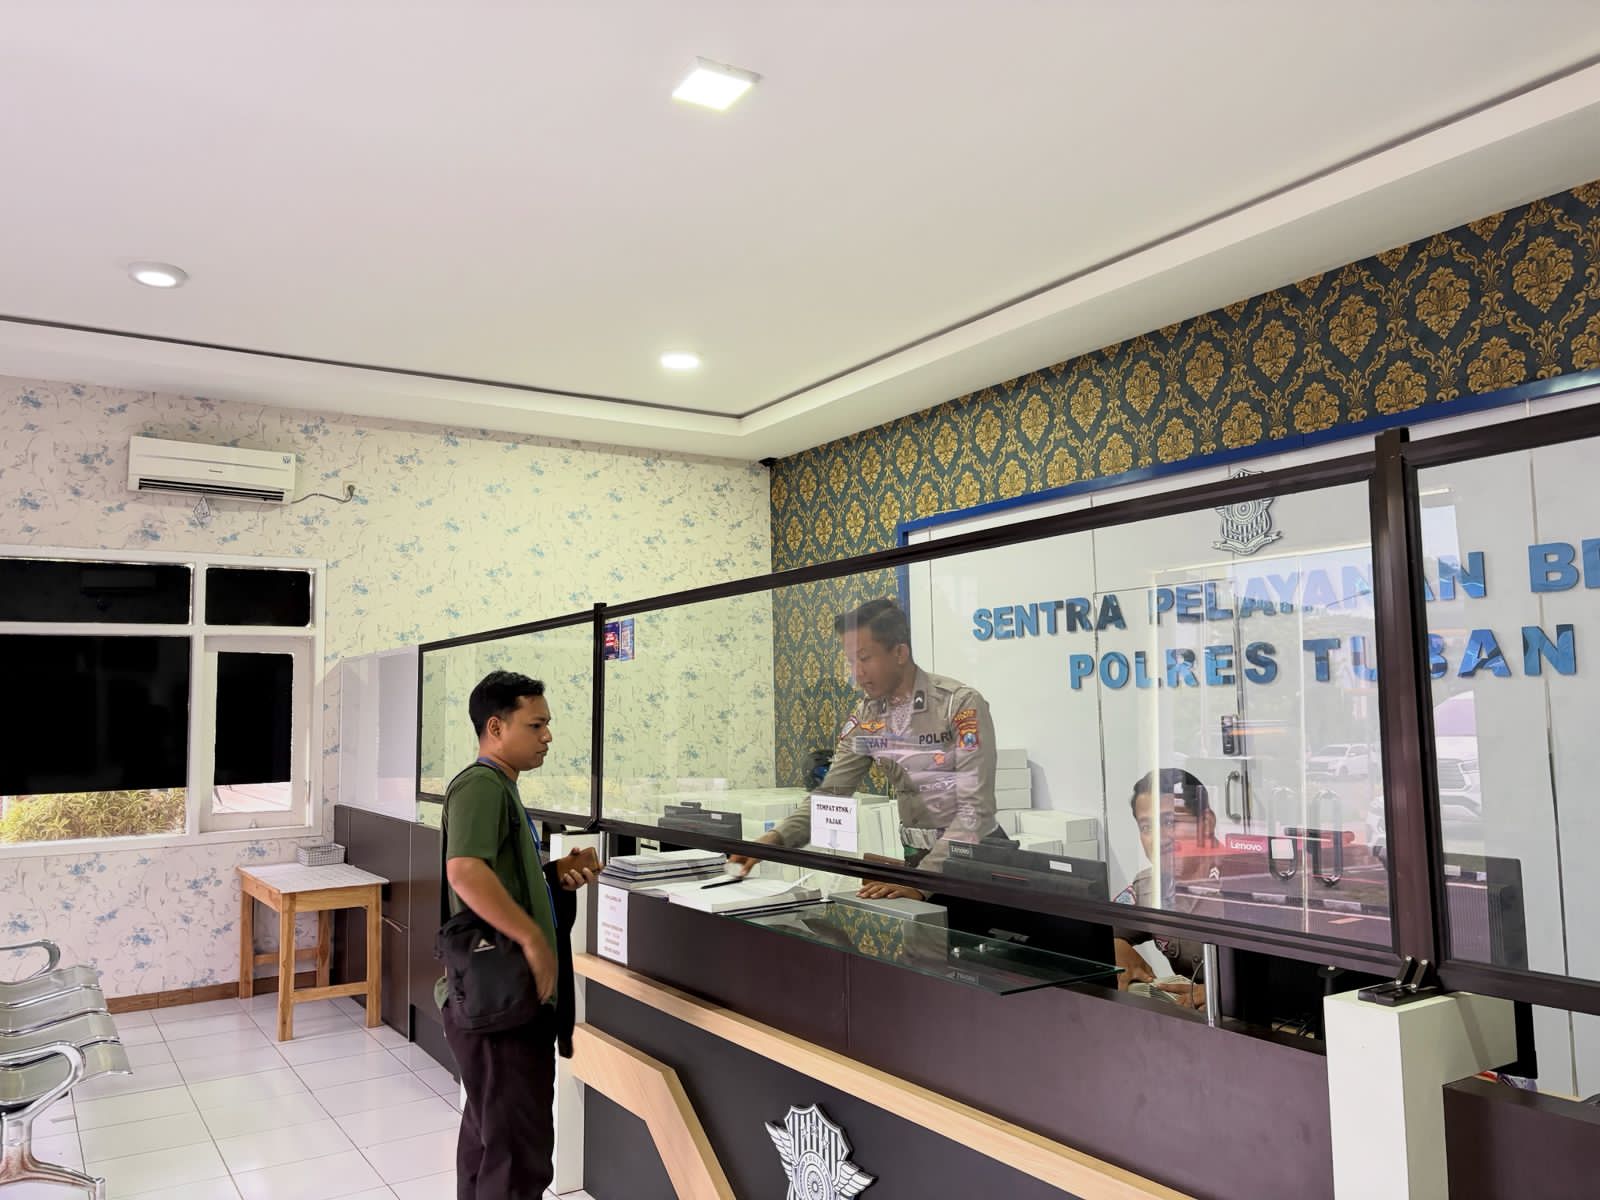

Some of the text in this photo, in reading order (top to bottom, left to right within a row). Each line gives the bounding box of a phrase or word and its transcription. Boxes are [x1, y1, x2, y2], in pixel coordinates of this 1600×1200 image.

[973, 594, 1127, 641] SENTRA
[1149, 551, 1487, 625] PELAYANN
[1069, 641, 1279, 690] POLRES
[919, 731, 952, 745] POLRI
[1230, 840, 1262, 851] Lenovo
